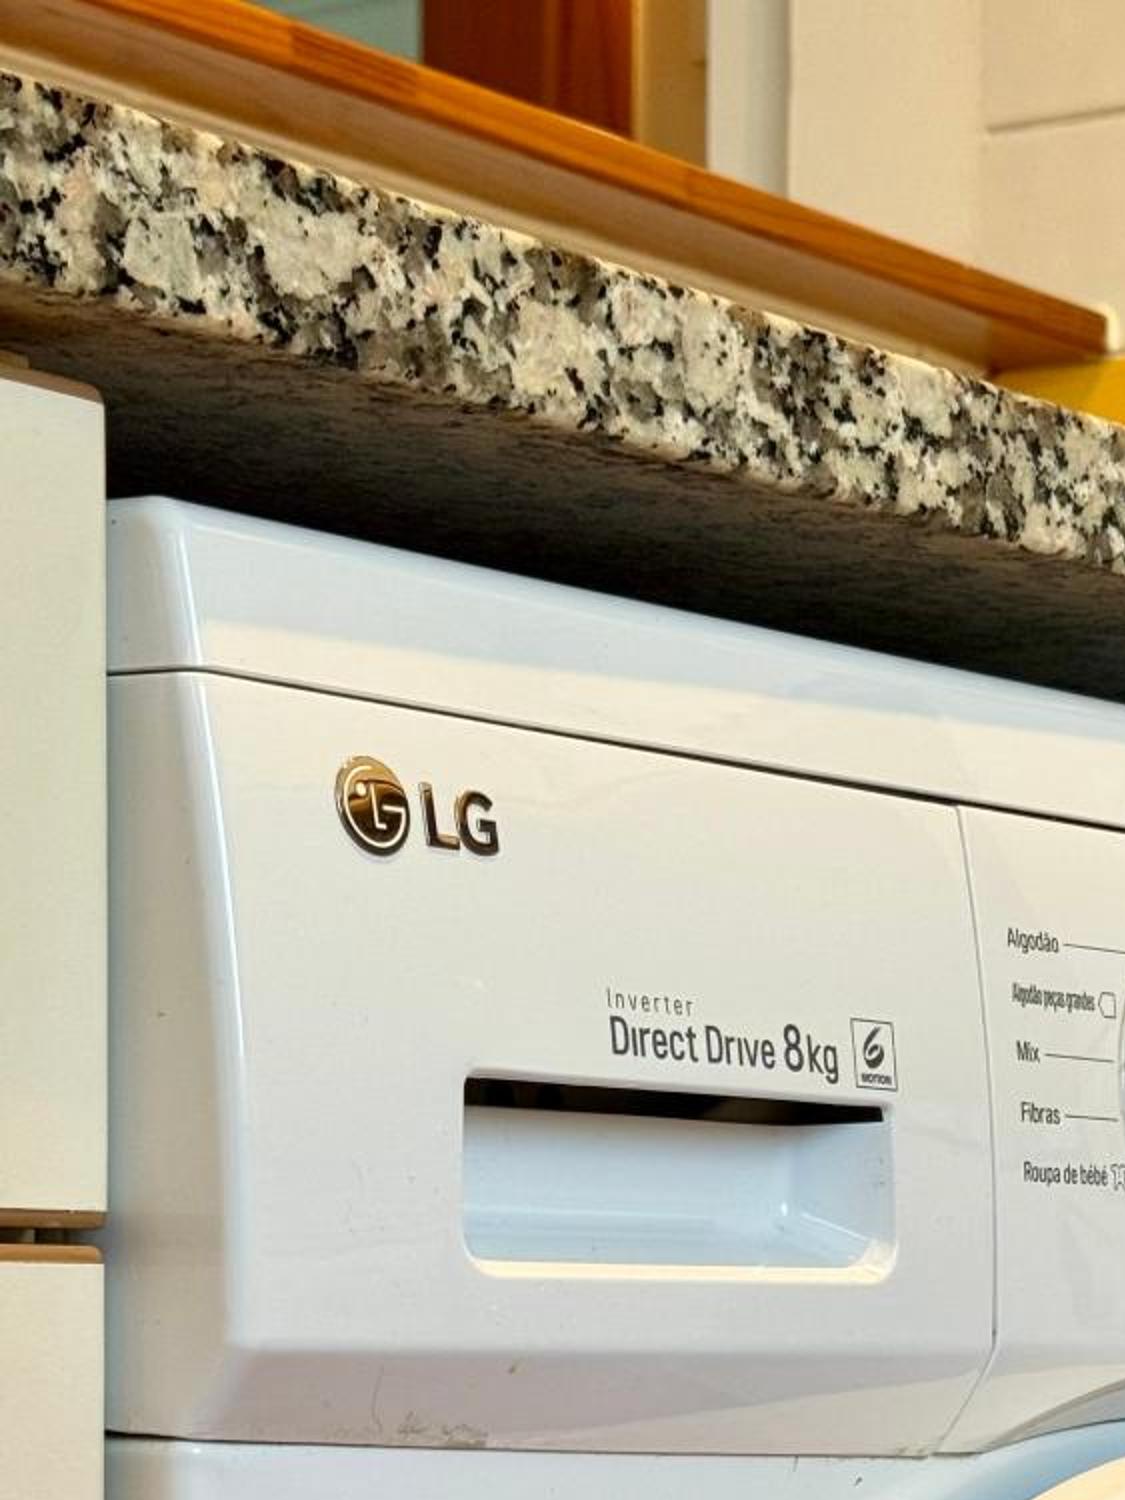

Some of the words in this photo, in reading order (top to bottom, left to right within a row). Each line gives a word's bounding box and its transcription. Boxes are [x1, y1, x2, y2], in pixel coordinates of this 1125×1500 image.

[418, 782, 500, 857] LG
[1007, 927, 1059, 954] Algodão
[606, 988, 694, 1016] Inverter
[610, 1015, 698, 1063] Direct
[705, 1025, 776, 1070] Drive
[1016, 1040, 1040, 1063] Mix
[1020, 1101, 1060, 1124] Fibras
[1023, 1161, 1060, 1187] Roupa
[1063, 1162, 1078, 1184] de
